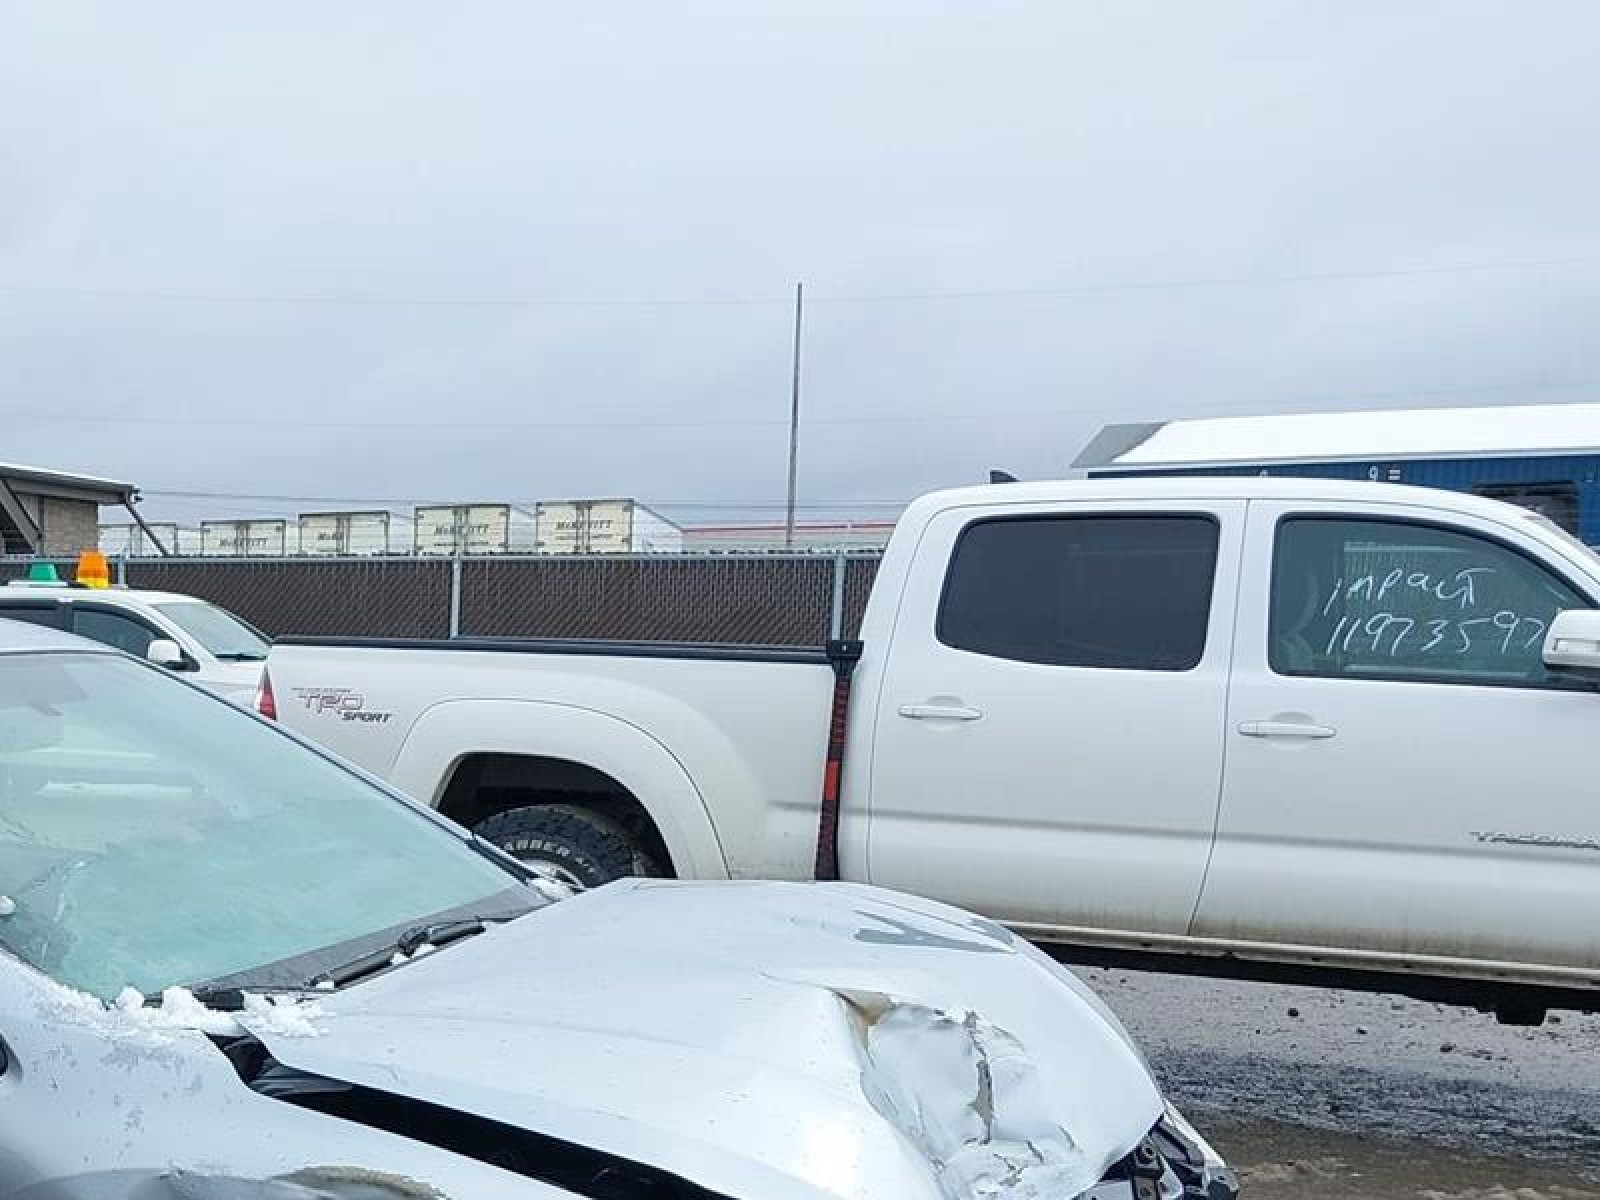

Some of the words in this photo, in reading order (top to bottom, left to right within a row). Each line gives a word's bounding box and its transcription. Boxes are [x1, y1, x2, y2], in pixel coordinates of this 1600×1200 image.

[1326, 611, 1544, 656] 11973597
[292, 687, 364, 715] TRD
[341, 711, 392, 722] SPORT
